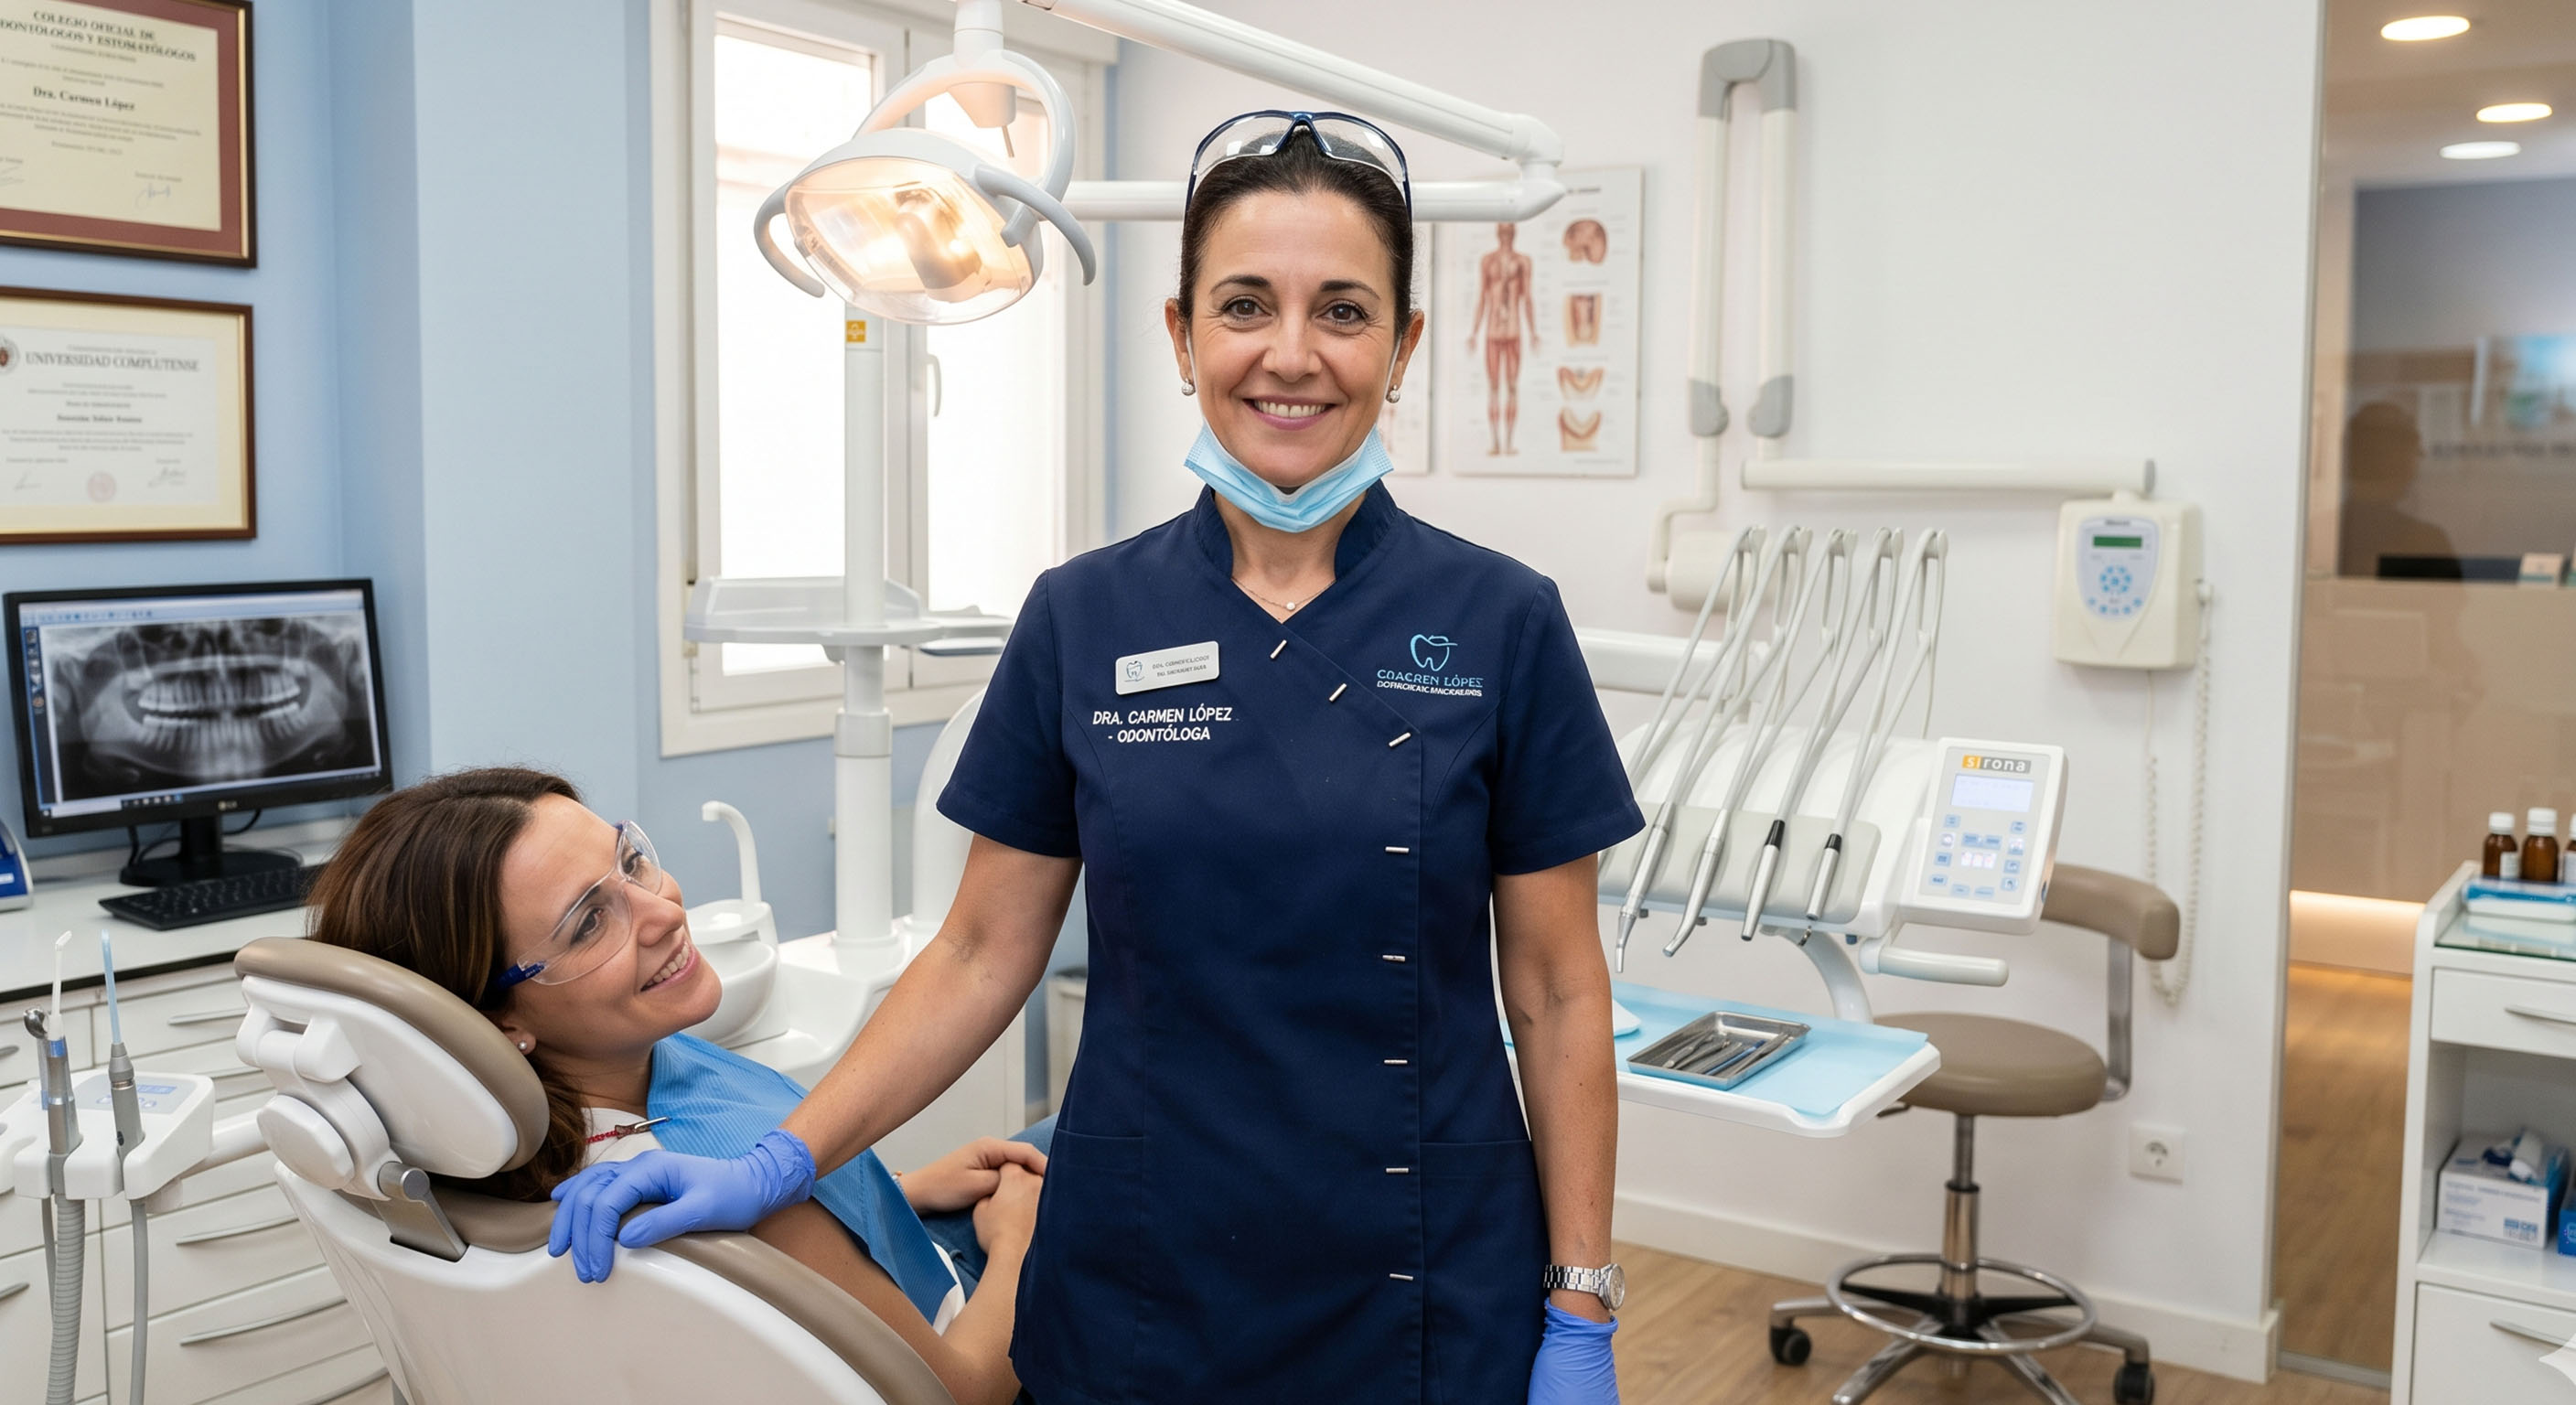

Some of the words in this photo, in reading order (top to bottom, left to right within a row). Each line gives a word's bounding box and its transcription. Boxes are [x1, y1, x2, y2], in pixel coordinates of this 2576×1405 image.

[26, 351, 111, 368] UNIVERSIDAD
[1092, 711, 1122, 724] DRA.
[1128, 708, 1184, 724] CARMEN
[1188, 702, 1232, 722] LÓPEZ
[1117, 724, 1210, 743] ODONTÓLOGA
[1968, 756, 2025, 772] sirona
